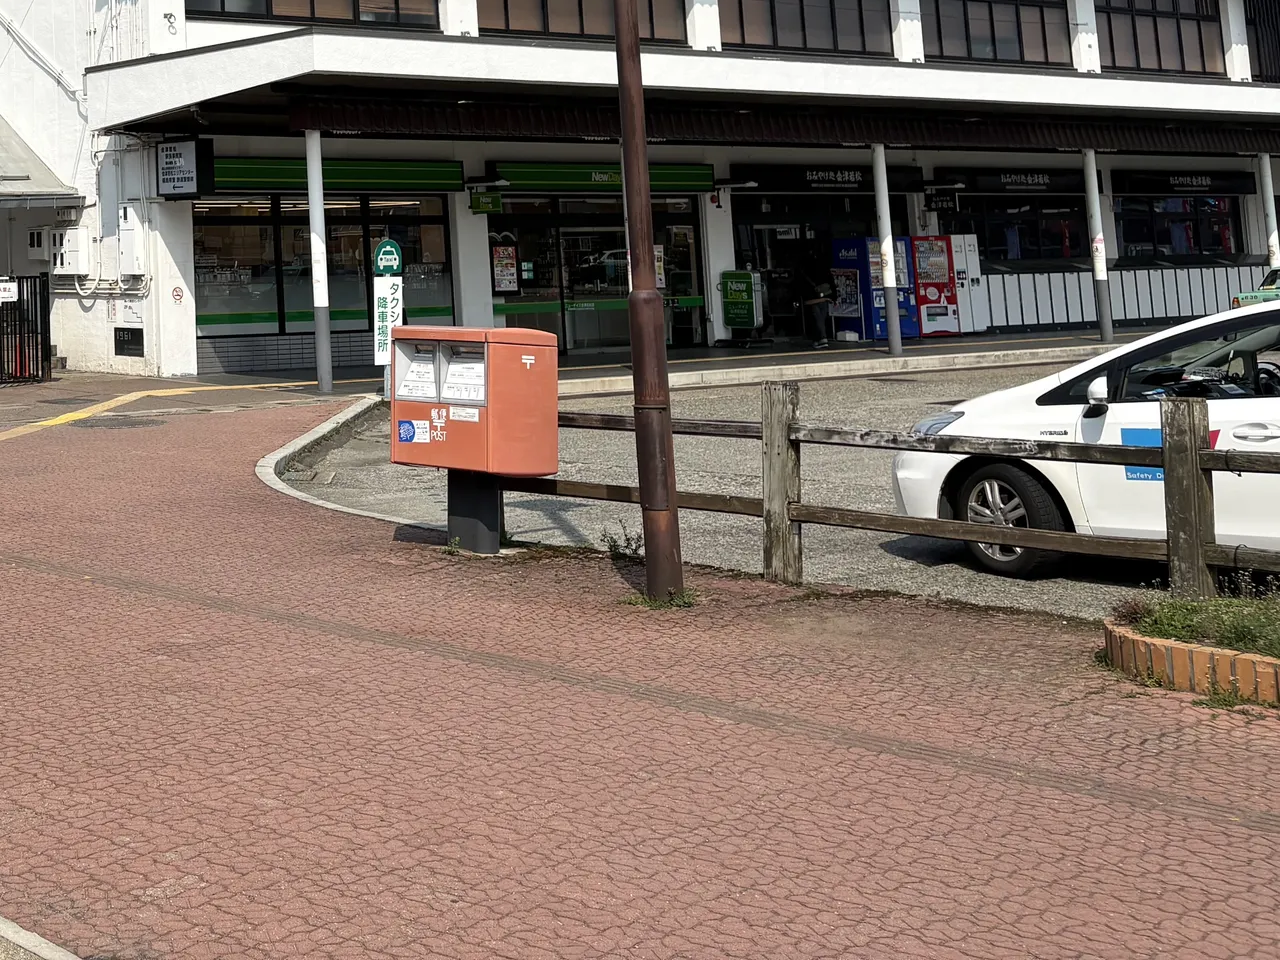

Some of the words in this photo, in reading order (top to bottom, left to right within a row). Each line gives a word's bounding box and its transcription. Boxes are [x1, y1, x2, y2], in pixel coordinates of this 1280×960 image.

[591, 171, 622, 183] NewDay
[727, 281, 747, 291] New
[389, 283, 400, 327] タクシ
[377, 297, 389, 353] 降車場所
[431, 408, 447, 420] 郵便
[430, 430, 447, 441] POST
[1126, 472, 1153, 480] Safety
